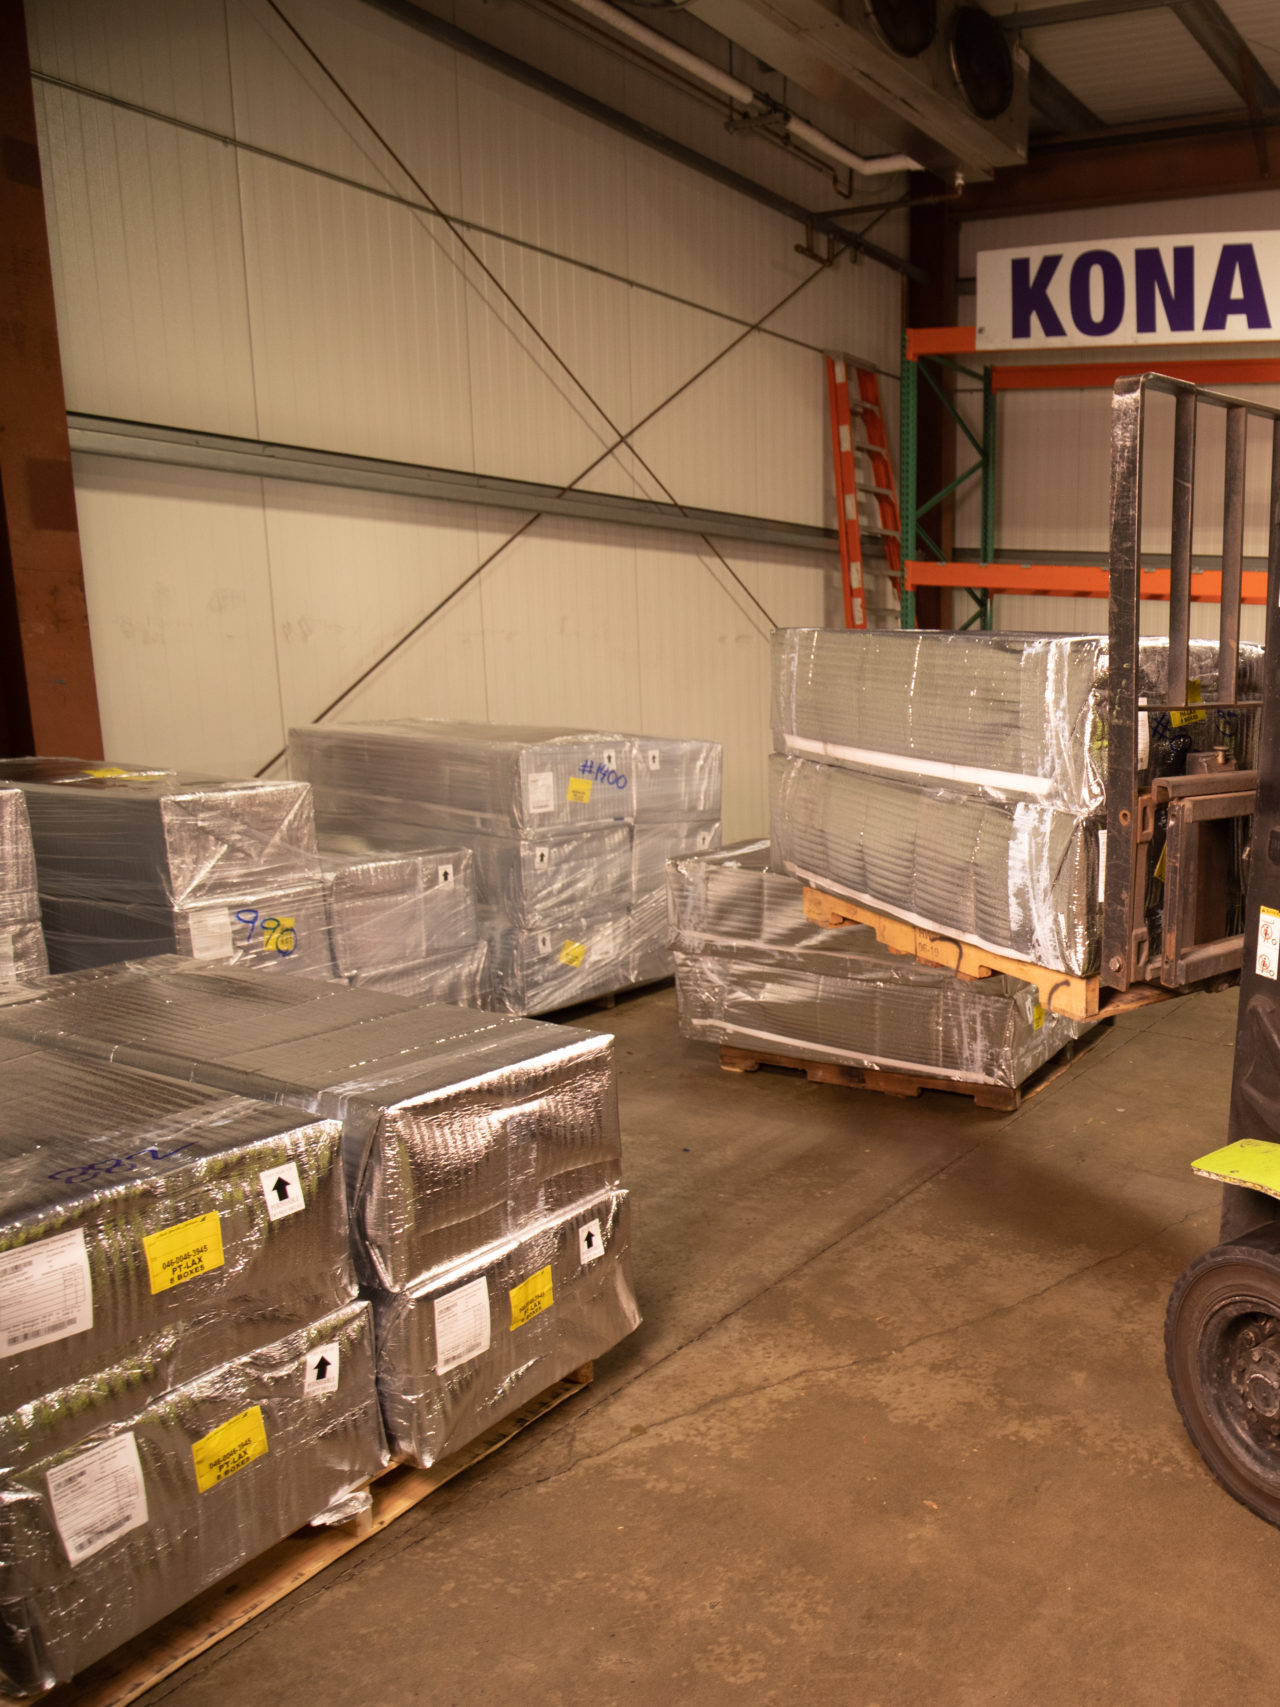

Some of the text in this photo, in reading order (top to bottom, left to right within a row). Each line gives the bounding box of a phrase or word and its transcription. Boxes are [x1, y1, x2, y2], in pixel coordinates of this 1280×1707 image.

[1012, 243, 1272, 339] KONA
[235, 908, 298, 958] 990
[177, 1265, 205, 1281] BOXES
